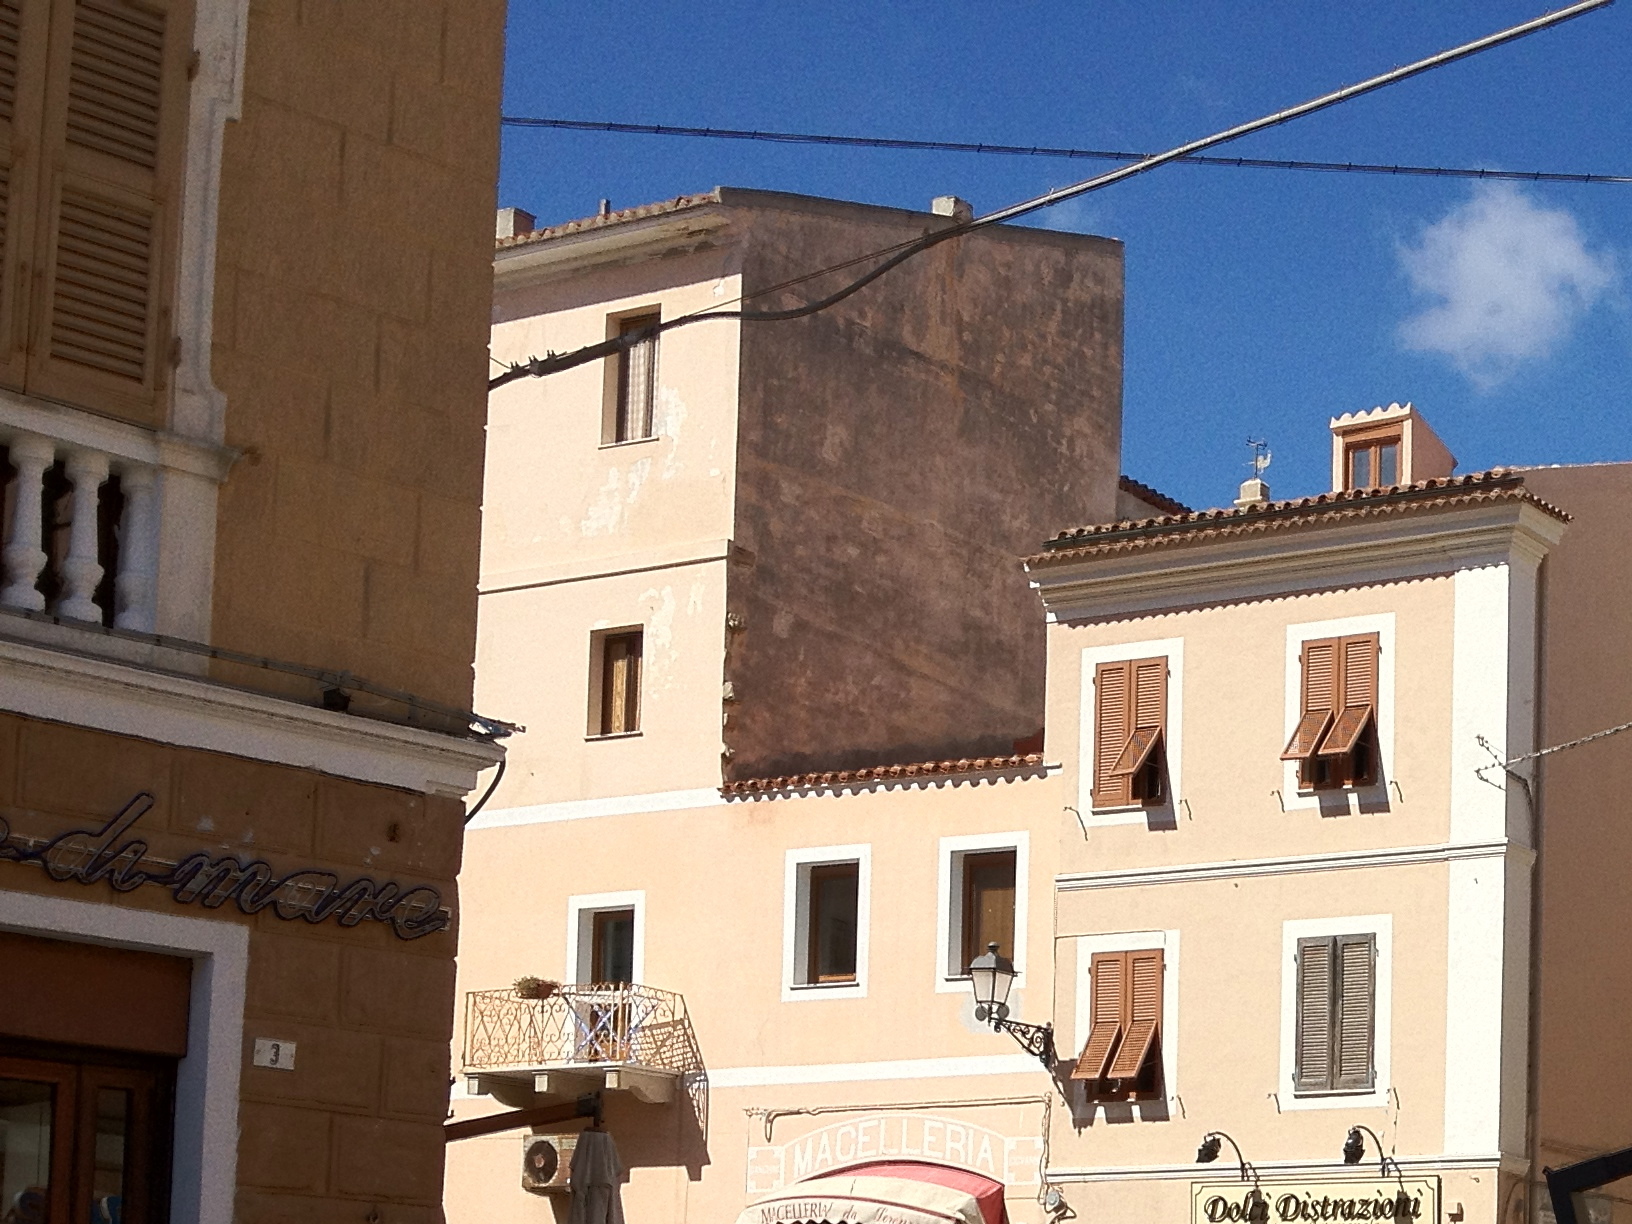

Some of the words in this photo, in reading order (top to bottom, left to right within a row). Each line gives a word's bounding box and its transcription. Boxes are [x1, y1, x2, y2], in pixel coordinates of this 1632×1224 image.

[270, 1043, 280, 1066] 3
[793, 1119, 995, 1179] MACELLERIA
[843, 1204, 858, 1221] da
[1204, 1189, 1272, 1223] Dolci
[1275, 1188, 1424, 1222] Distrazioni
